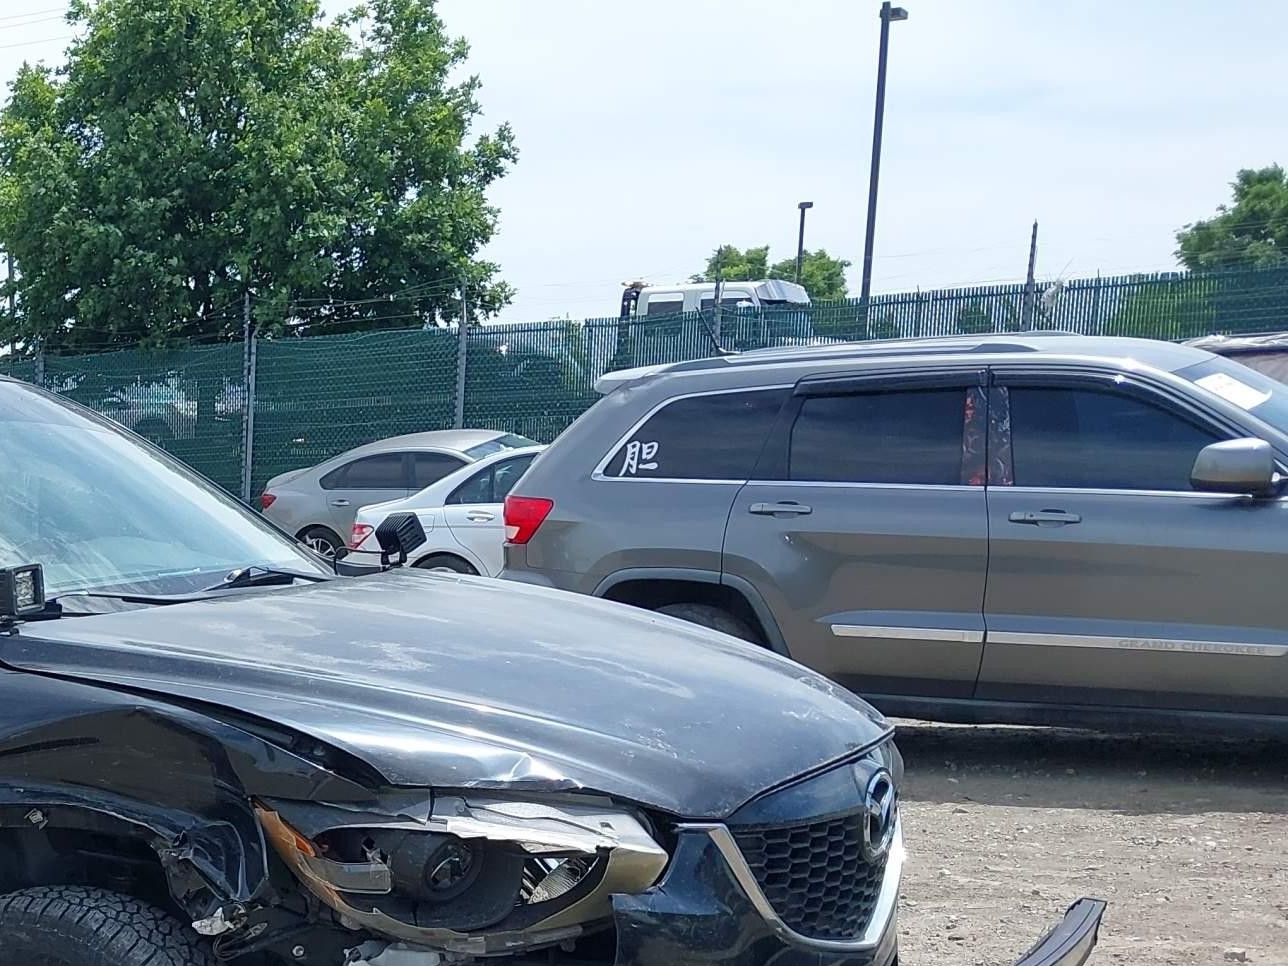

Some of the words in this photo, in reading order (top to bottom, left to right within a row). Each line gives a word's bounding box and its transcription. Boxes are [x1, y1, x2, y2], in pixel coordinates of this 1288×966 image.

[618, 440, 659, 477] 胆
[1118, 638, 1176, 650] GRAND
[1181, 642, 1266, 654] CHEROKEE
